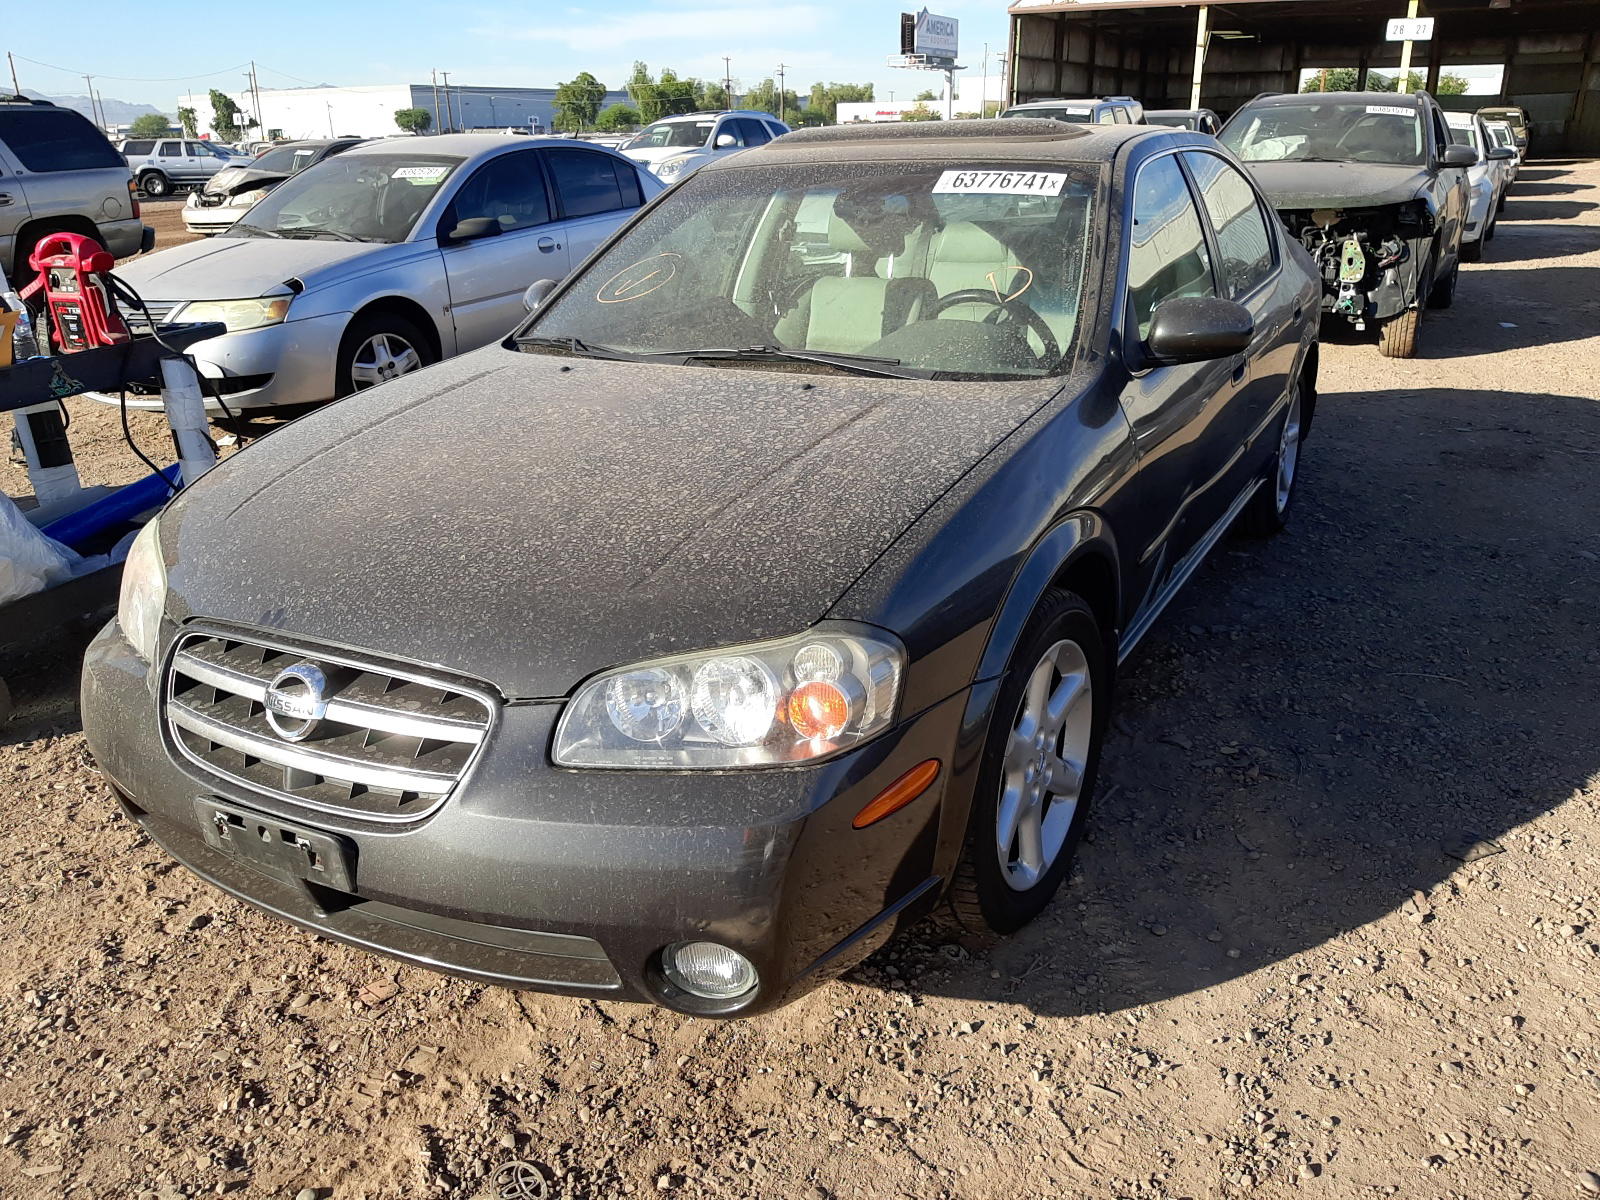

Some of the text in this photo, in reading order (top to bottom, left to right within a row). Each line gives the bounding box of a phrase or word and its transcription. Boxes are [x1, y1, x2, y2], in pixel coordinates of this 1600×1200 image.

[926, 19, 955, 37] AMERICA
[1392, 24, 1427, 35] 28 27
[952, 172, 1049, 190] 63776741
[264, 692, 315, 716] NISSAN
